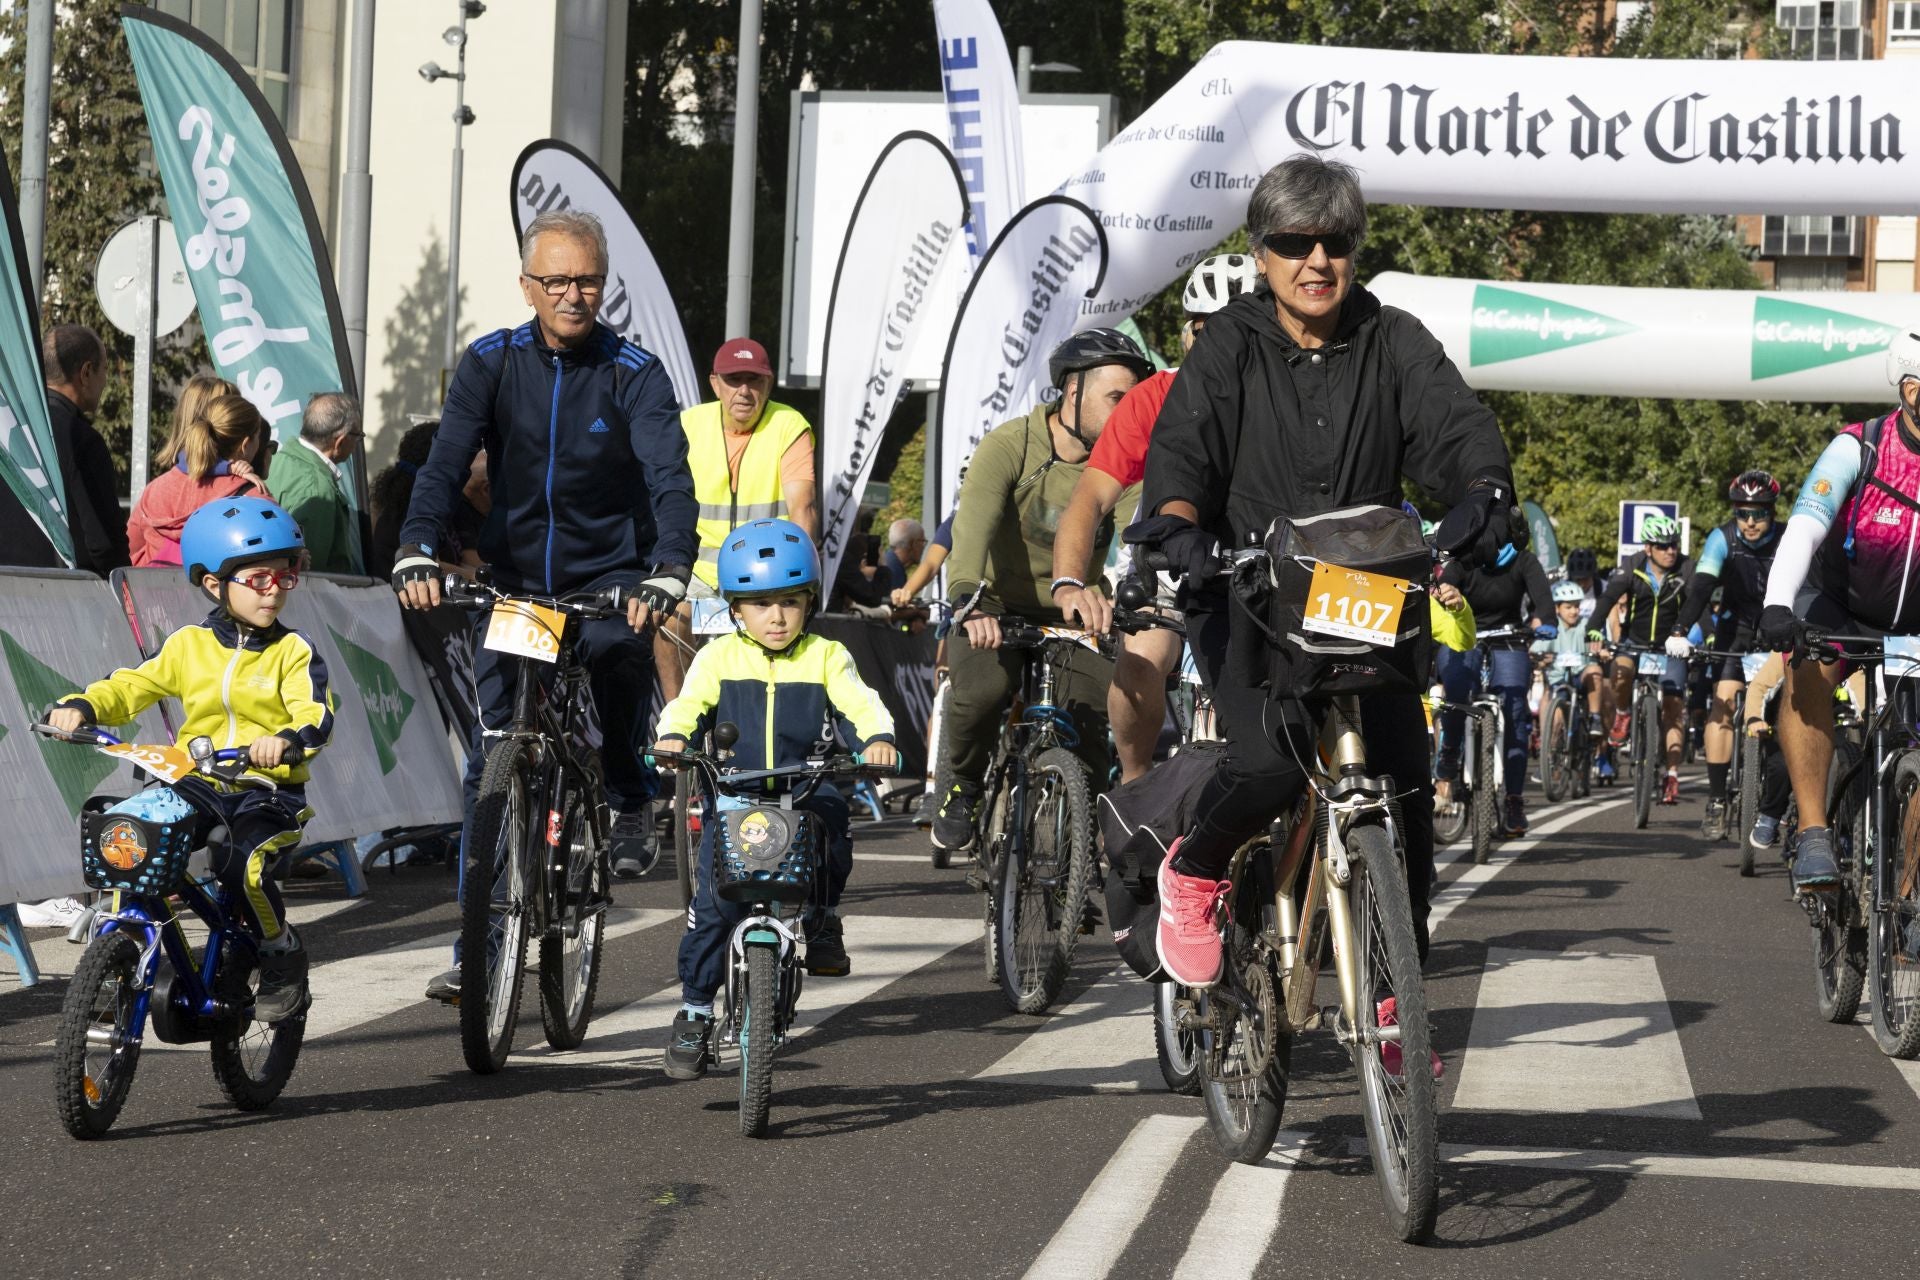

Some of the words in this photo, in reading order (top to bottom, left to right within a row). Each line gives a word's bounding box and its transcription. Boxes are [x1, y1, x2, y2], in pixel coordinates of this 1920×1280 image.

[1164, 123, 1225, 143] Castilla
[1285, 79, 1366, 151] El
[1382, 82, 1554, 160] Norte
[1566, 94, 1633, 162] de
[1643, 91, 1907, 165] Castilla
[1190, 170, 1210, 189] El
[1215, 171, 1255, 190] Norte
[1135, 213, 1151, 230] de
[1153, 213, 1213, 232] Castilla
[885, 218, 954, 353] Castilla
[980, 371, 1014, 413] de
[1001, 225, 1098, 370] Castilla
[1314, 592, 1393, 631] 1107
[495, 620, 553, 651] 106
